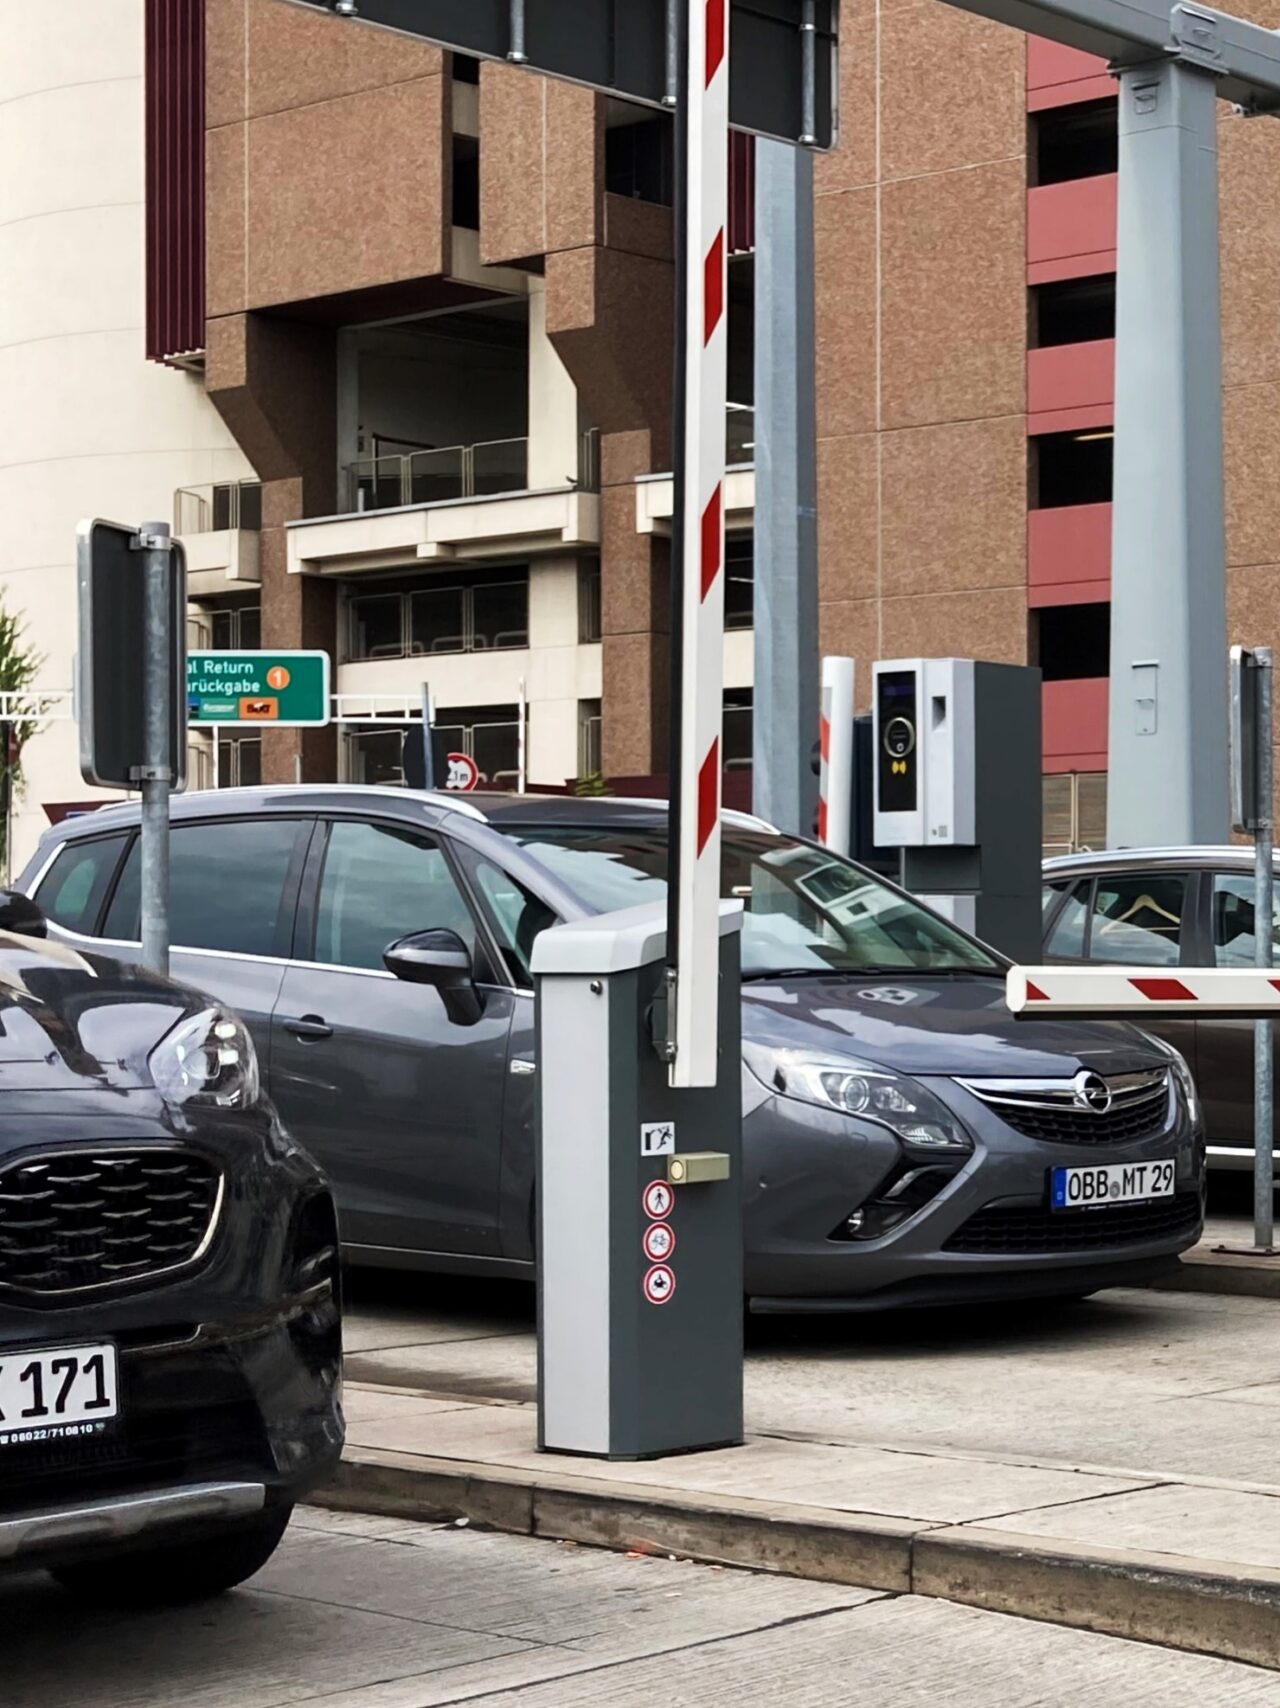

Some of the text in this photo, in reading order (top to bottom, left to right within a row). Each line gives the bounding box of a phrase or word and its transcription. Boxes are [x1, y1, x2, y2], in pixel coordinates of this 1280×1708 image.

[203, 660, 254, 674] Return
[273, 670, 282, 687] 1
[1068, 1163, 1173, 1200] OBB MT 29
[20, 1354, 110, 1418] 171
